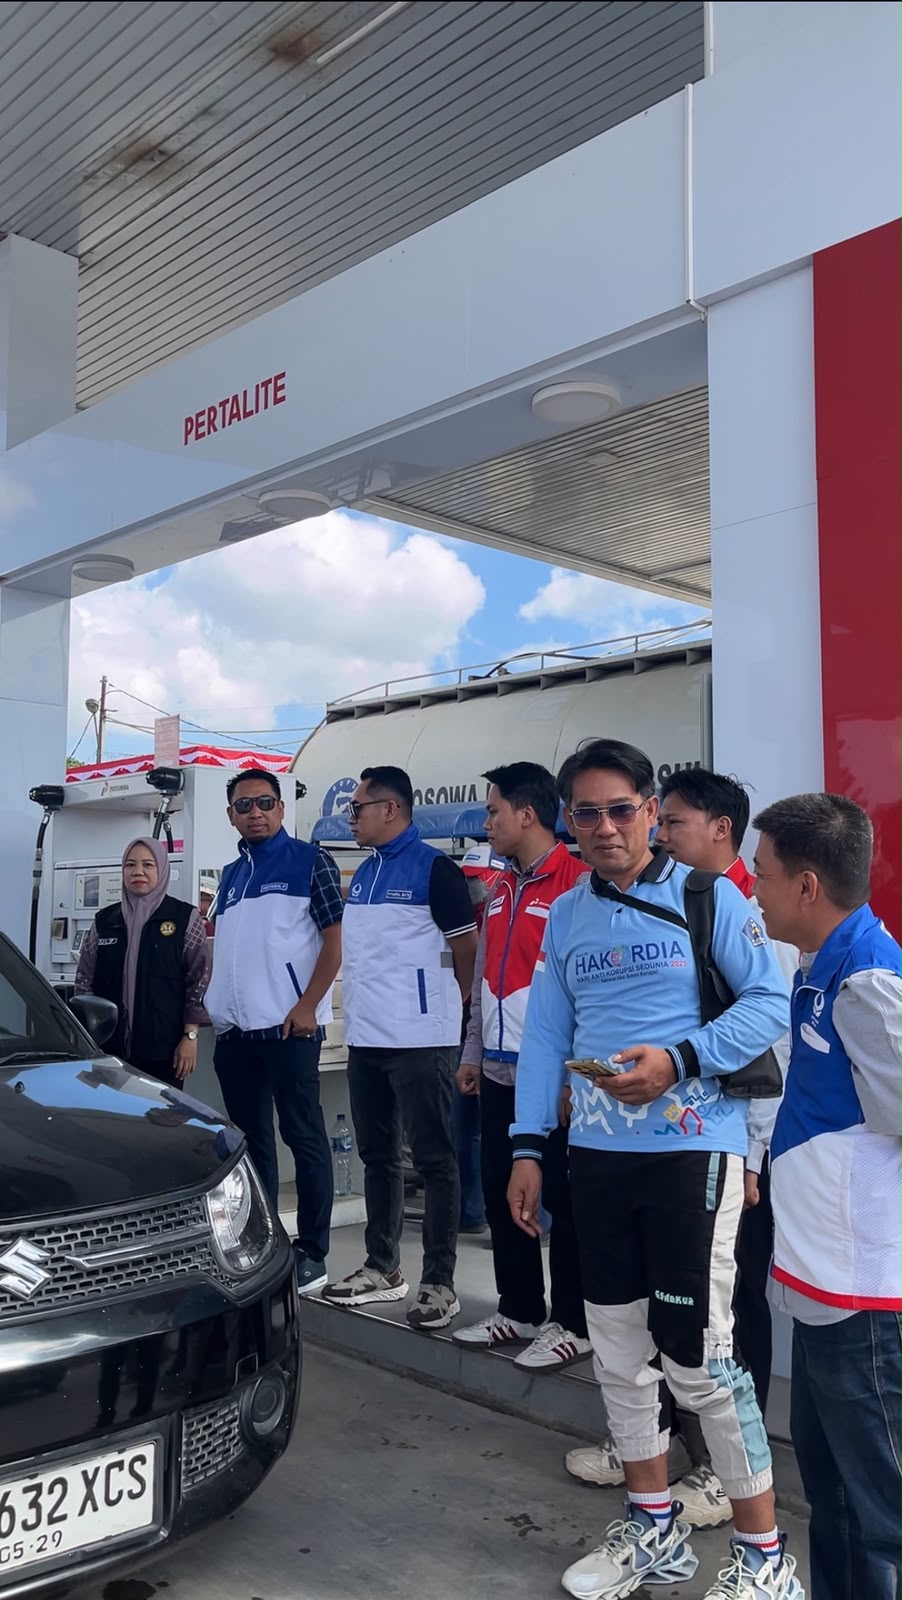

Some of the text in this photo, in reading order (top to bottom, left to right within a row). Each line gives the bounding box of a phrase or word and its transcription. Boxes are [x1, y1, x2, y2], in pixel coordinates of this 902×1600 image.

[184, 371, 286, 446] PERTALITE
[413, 784, 477, 805] OSOWA
[577, 974, 590, 983] HARI
[591, 971, 607, 981] ANTI
[607, 966, 635, 977] KORUPSI
[635, 961, 669, 972] SEDUNIA
[78, 1454, 147, 1517] XCS
